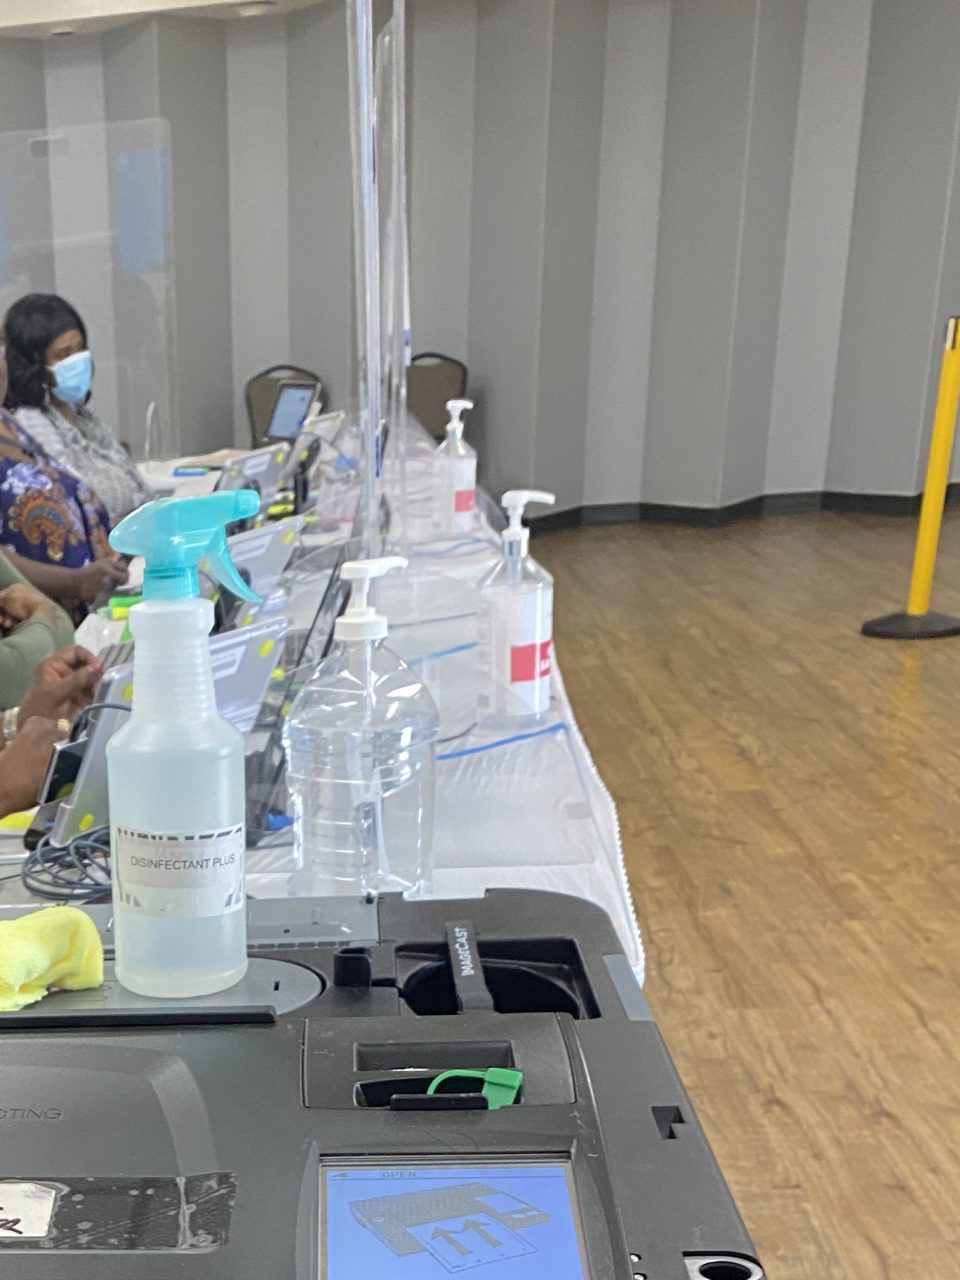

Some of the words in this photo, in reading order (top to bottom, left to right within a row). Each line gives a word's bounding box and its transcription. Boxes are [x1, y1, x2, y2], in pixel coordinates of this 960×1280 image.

[130, 856, 210, 871] DISINFECTANT
[213, 854, 236, 867] PLUS
[454, 926, 476, 977] IMAGECAST
